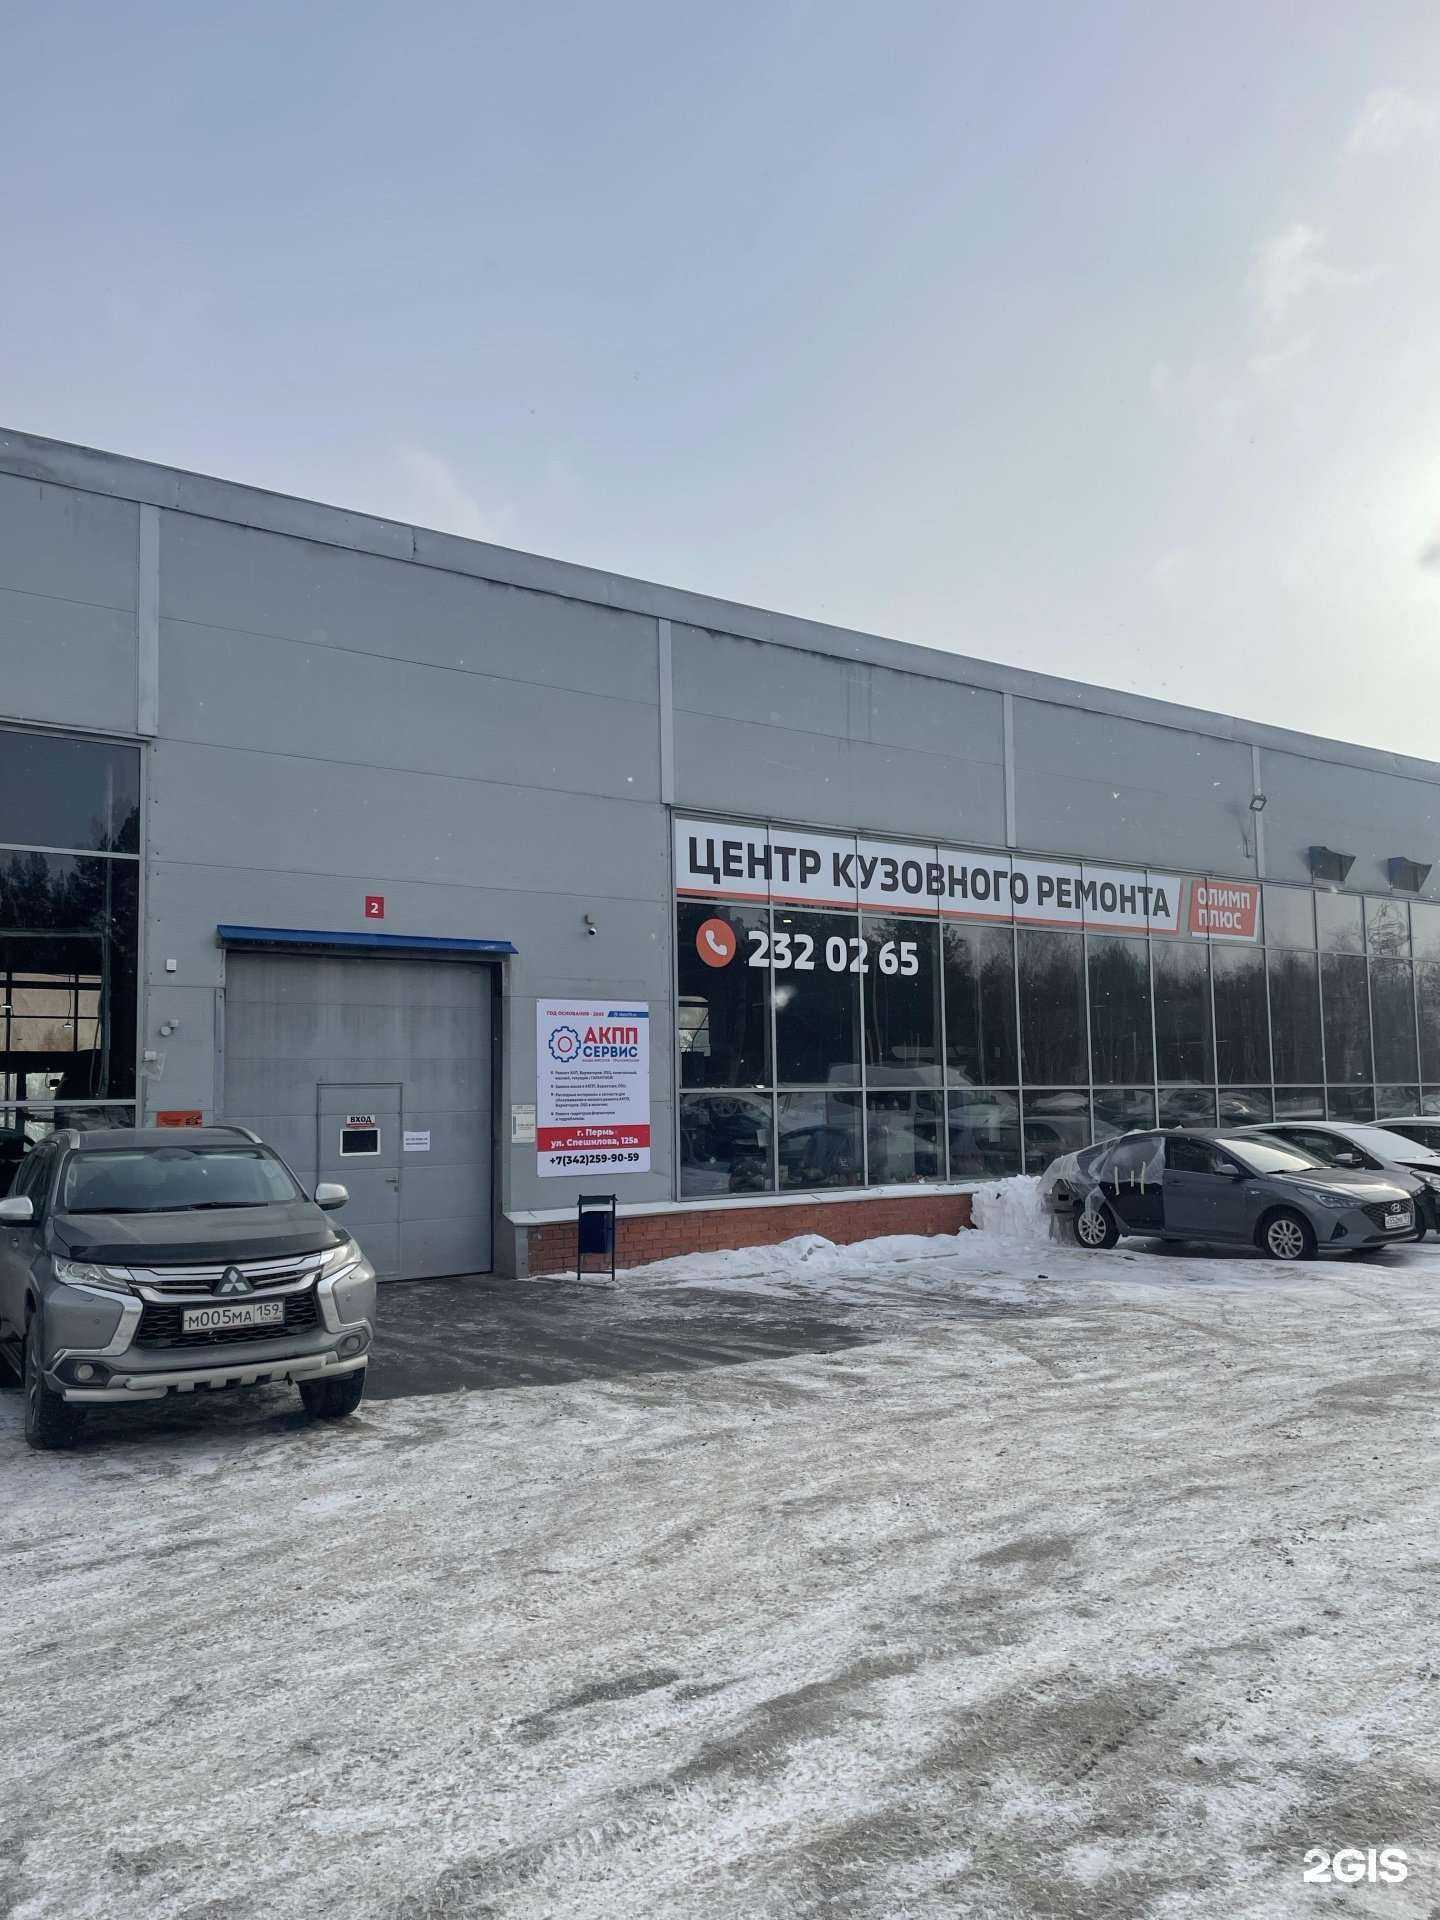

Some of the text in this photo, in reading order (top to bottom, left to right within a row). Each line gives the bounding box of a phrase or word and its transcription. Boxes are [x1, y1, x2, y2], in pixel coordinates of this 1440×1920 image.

[688, 836, 1171, 918] ЦЕНТР КУЗОВНОГО РЕМОНТА
[1197, 886, 1251, 910] ОЛИМП
[370, 902, 379, 914] 2
[1198, 907, 1243, 930] ПЛЮС
[748, 930, 919, 976] 232 02 65
[583, 1026, 638, 1044] АКПП
[583, 1046, 638, 1058] СЕРВИС
[350, 1115, 372, 1123] ВХОД
[586, 1128, 615, 1137] Пермь
[551, 1140, 565, 1149] ул.
[567, 1138, 619, 1147] Спешилова,
[550, 1152, 640, 1167] +7(342)259-90-59
[188, 1303, 280, 1328] М005МА 159
